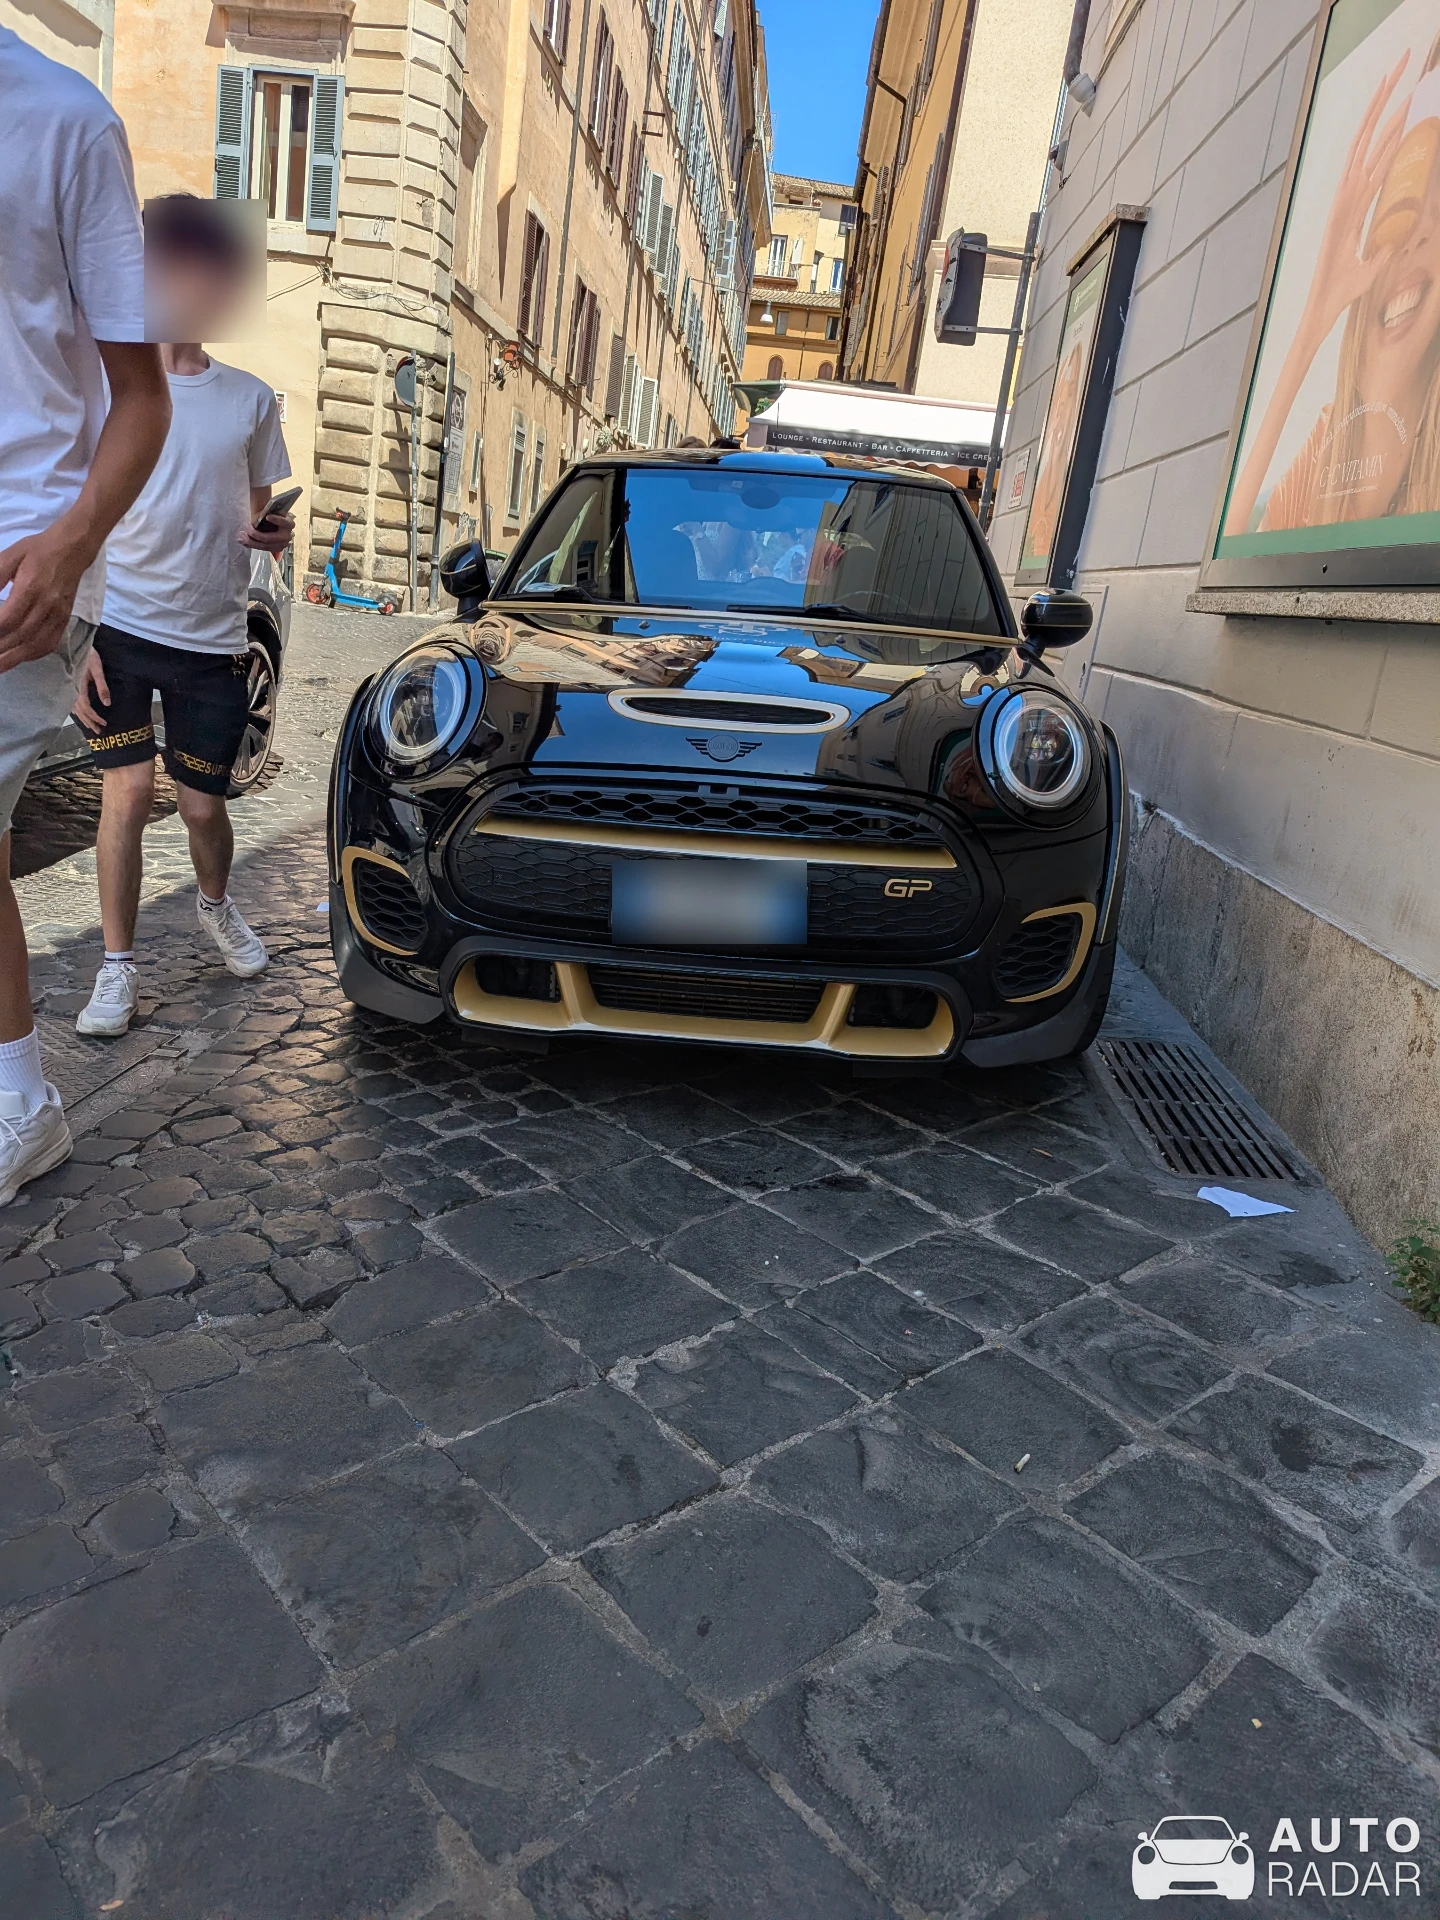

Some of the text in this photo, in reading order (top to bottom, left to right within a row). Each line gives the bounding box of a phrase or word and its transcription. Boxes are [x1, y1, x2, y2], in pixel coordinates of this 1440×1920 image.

[772, 432, 803, 442] LOUNGE
[812, 437, 863, 448] RESTAURANT
[872, 443, 888, 451] BAR
[895, 445, 949, 457] CAFFETTERIA
[957, 451, 970, 459] ICE
[1341, 453, 1387, 483] VITAMIN
[99, 732, 131, 750] SUPER
[884, 878, 933, 898] GP
